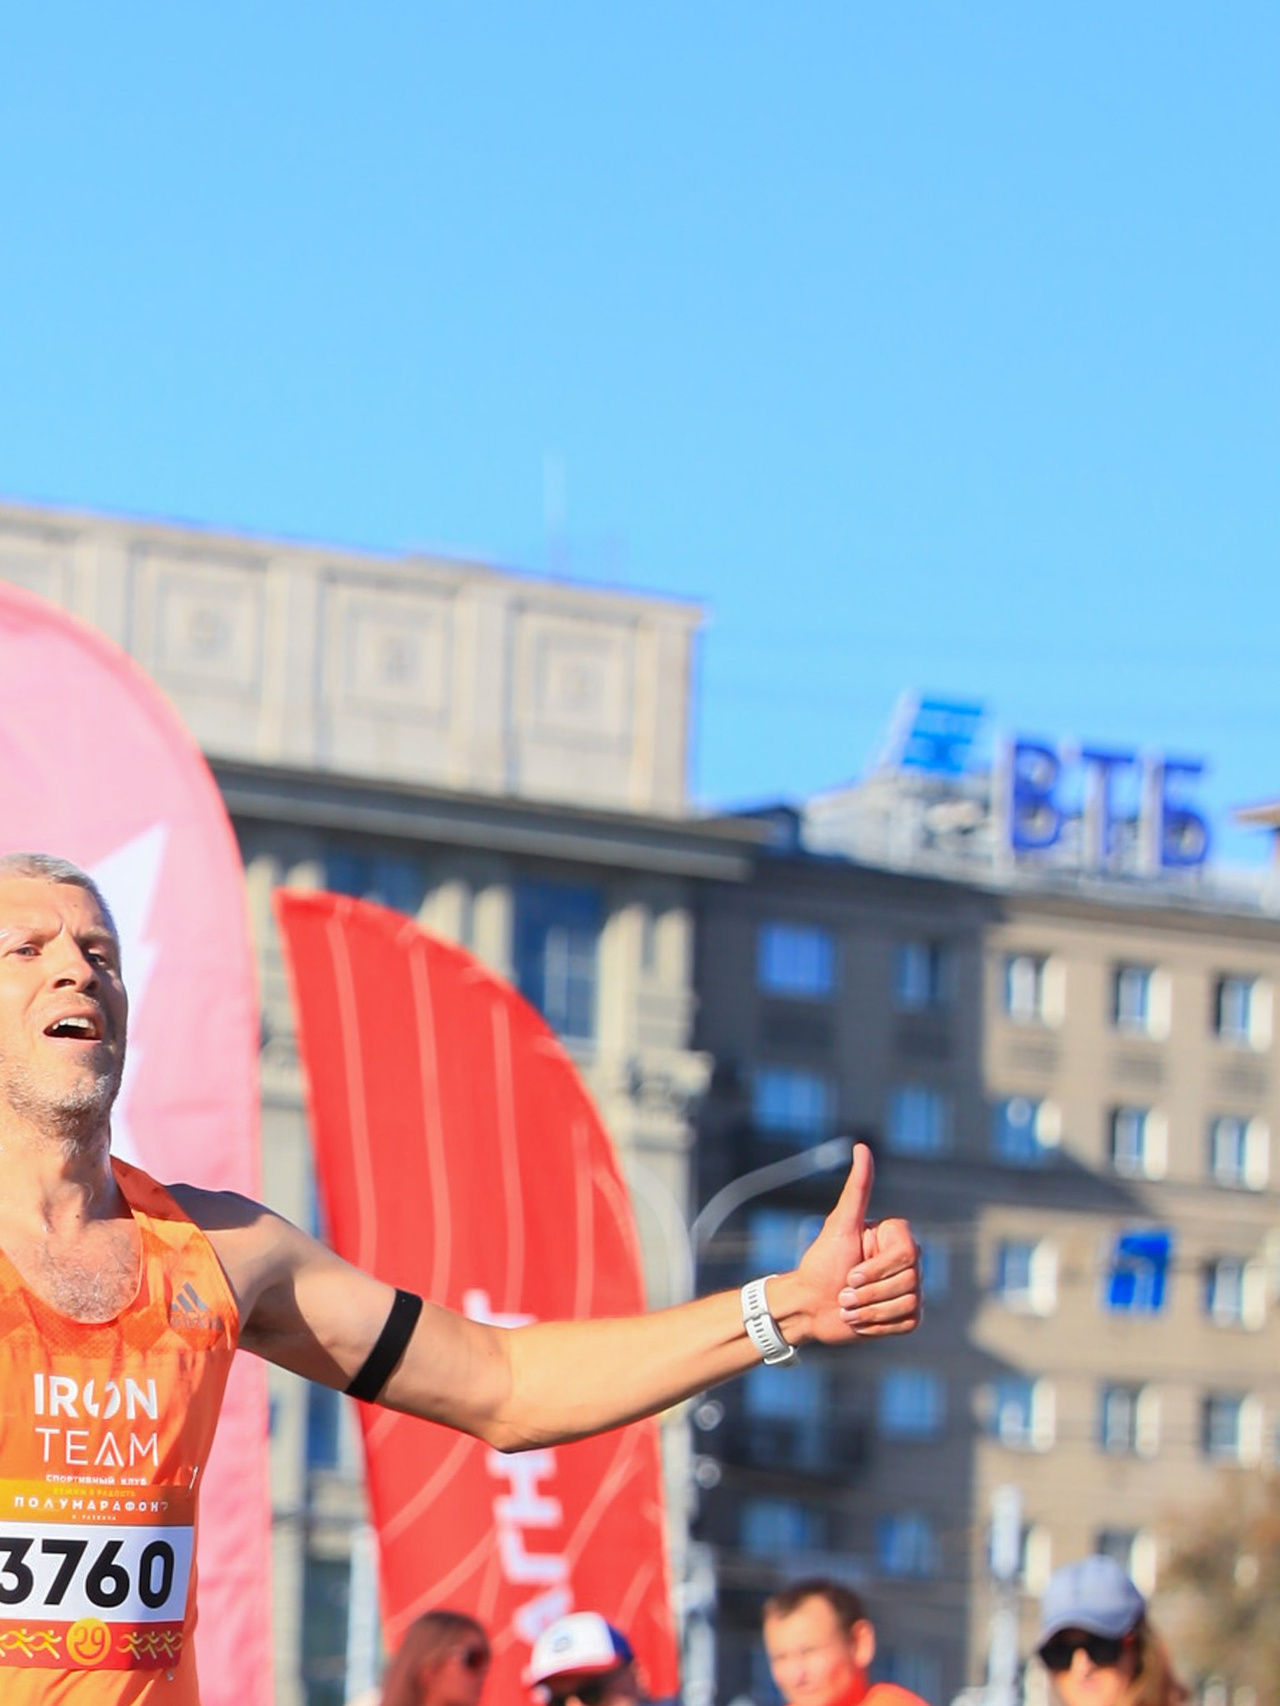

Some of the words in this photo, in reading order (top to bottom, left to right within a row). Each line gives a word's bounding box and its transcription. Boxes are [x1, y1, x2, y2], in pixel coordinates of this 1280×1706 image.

[1008, 738, 1211, 868] ВТБ
[33, 1373, 159, 1420] IRON
[34, 1427, 160, 1468] TEAM
[45, 1473, 116, 1485] СПОРТИВНЫЙ
[120, 1477, 148, 1486] КЛУБ
[14, 1496, 160, 1512] ПОЛУМАРАФОН
